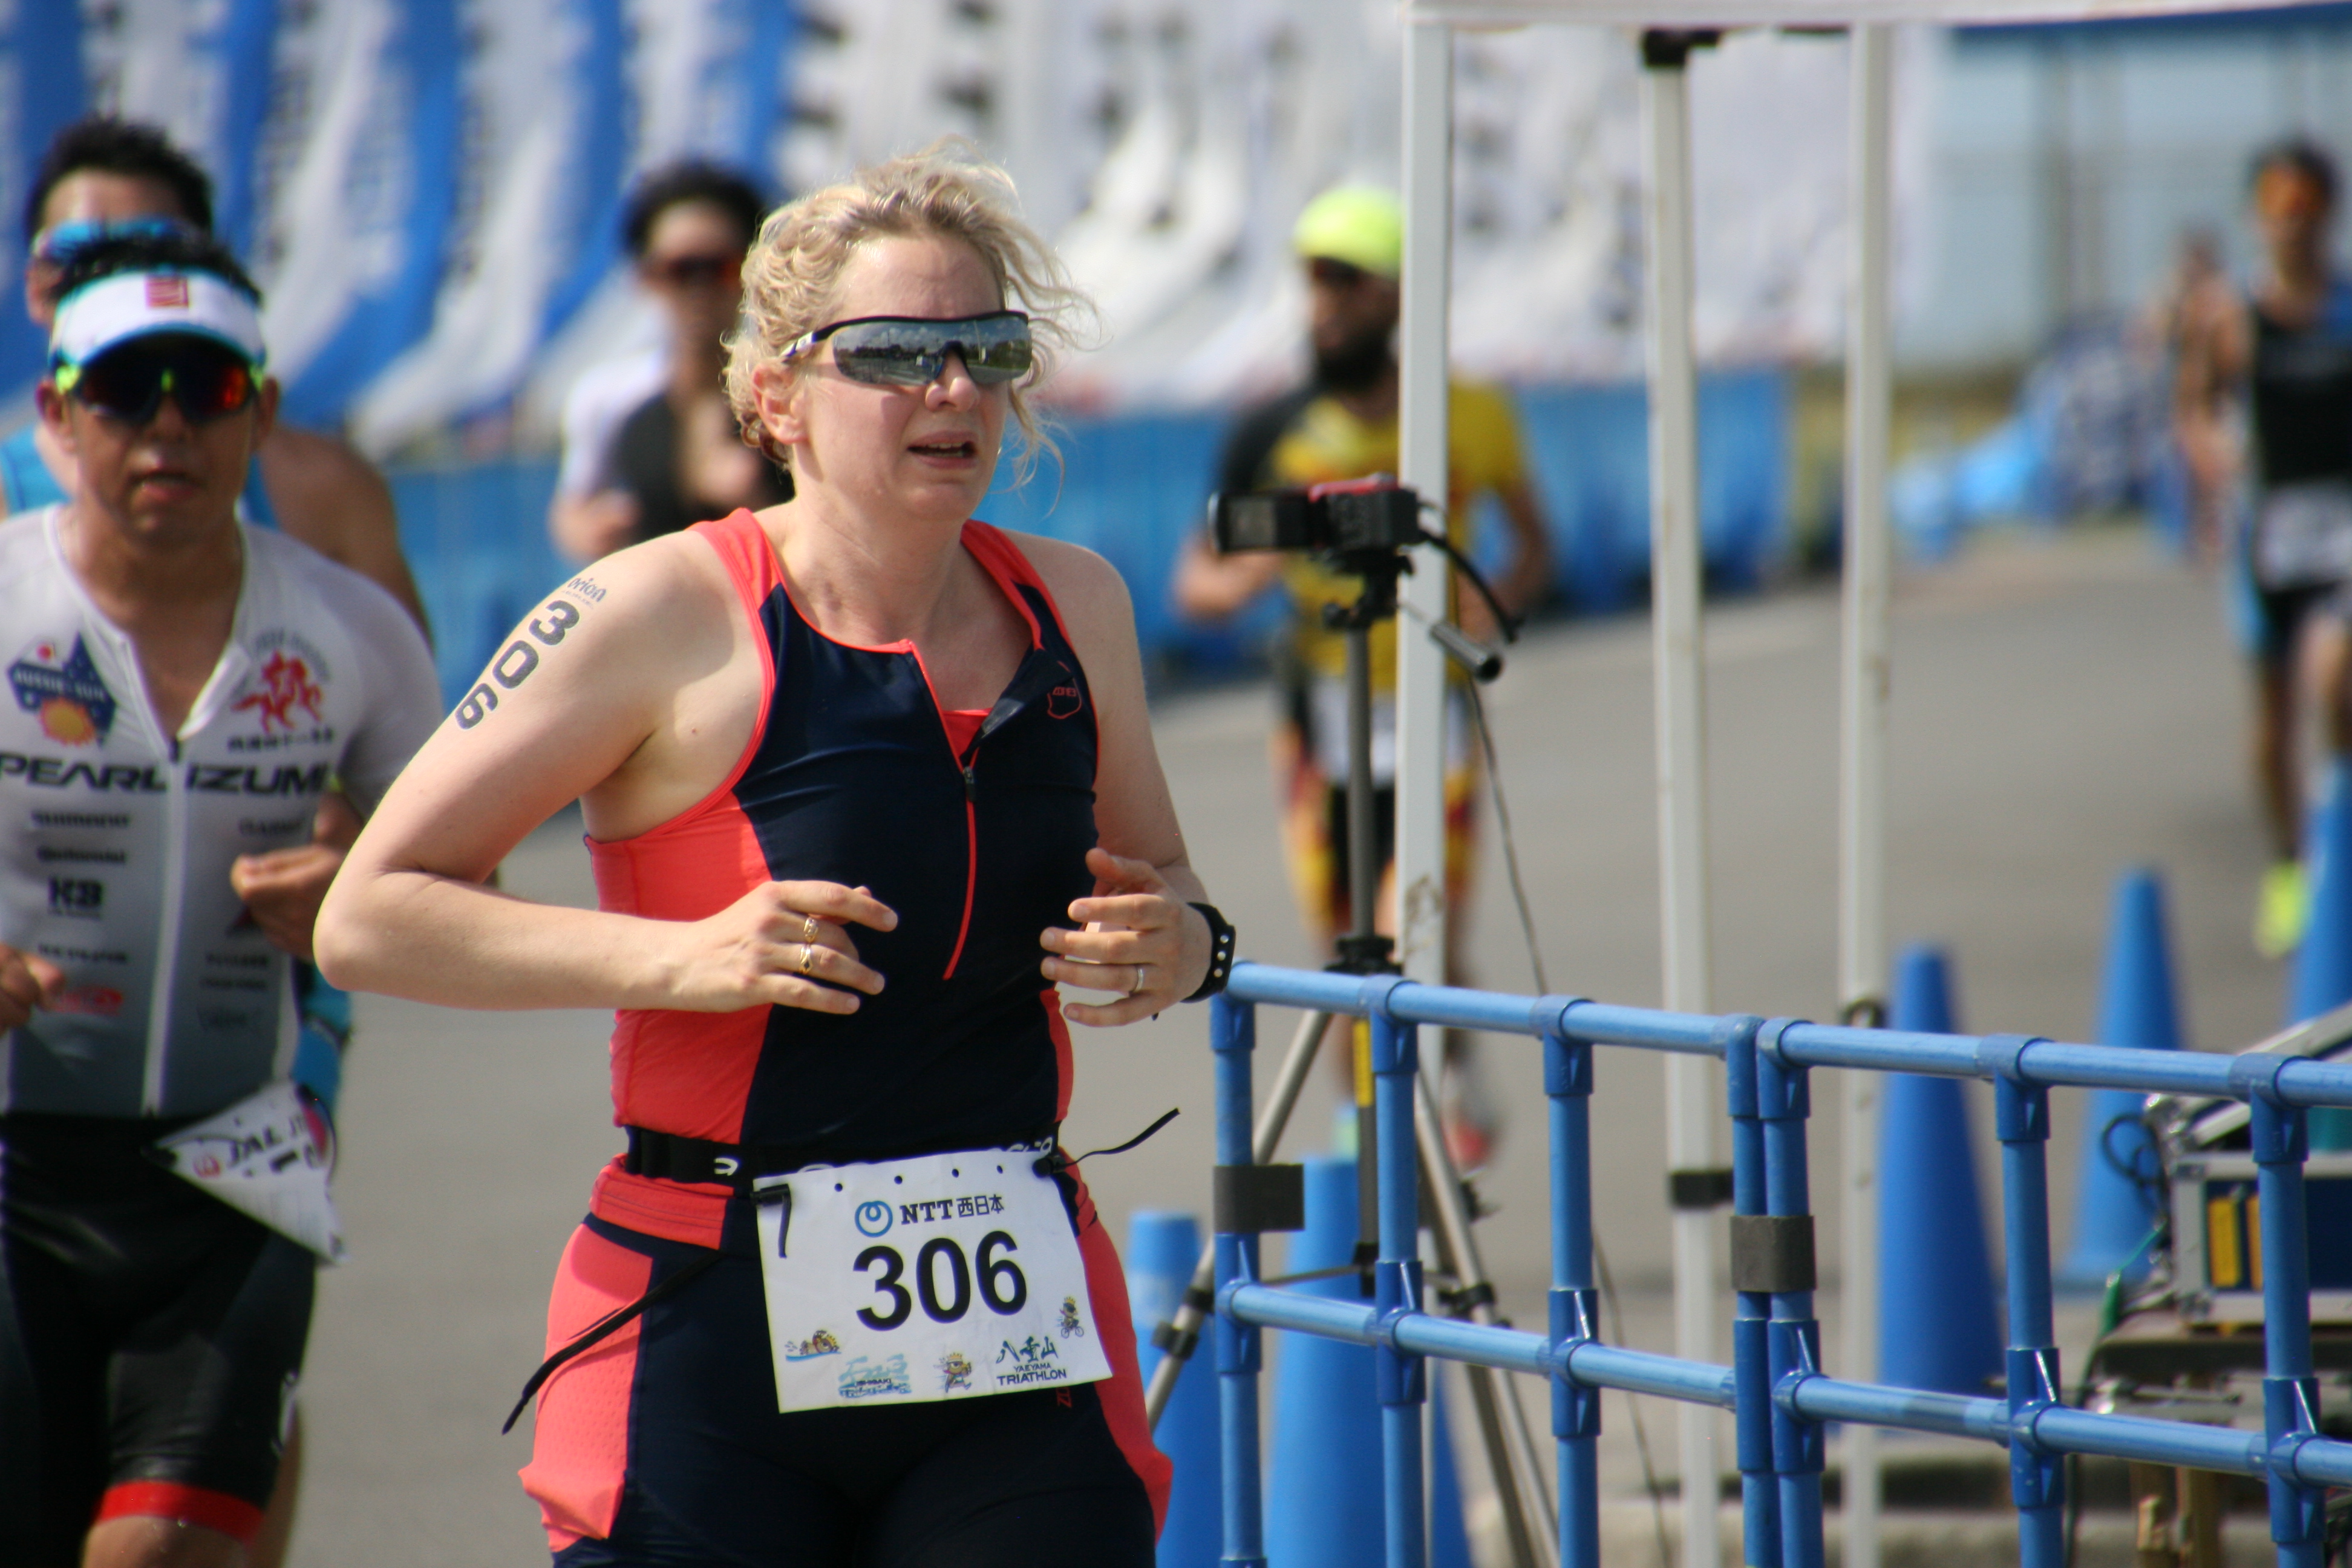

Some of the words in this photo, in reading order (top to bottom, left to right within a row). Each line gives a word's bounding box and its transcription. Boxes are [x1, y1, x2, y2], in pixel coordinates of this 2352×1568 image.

[0, 752, 168, 792] PEARL
[900, 1198, 954, 1225] NTT
[958, 1194, 1004, 1218] 西日本
[852, 1230, 1027, 1331] 306
[996, 1369, 1067, 1386] TRIATHLON
[1013, 1362, 1051, 1373] YAEYAMA
